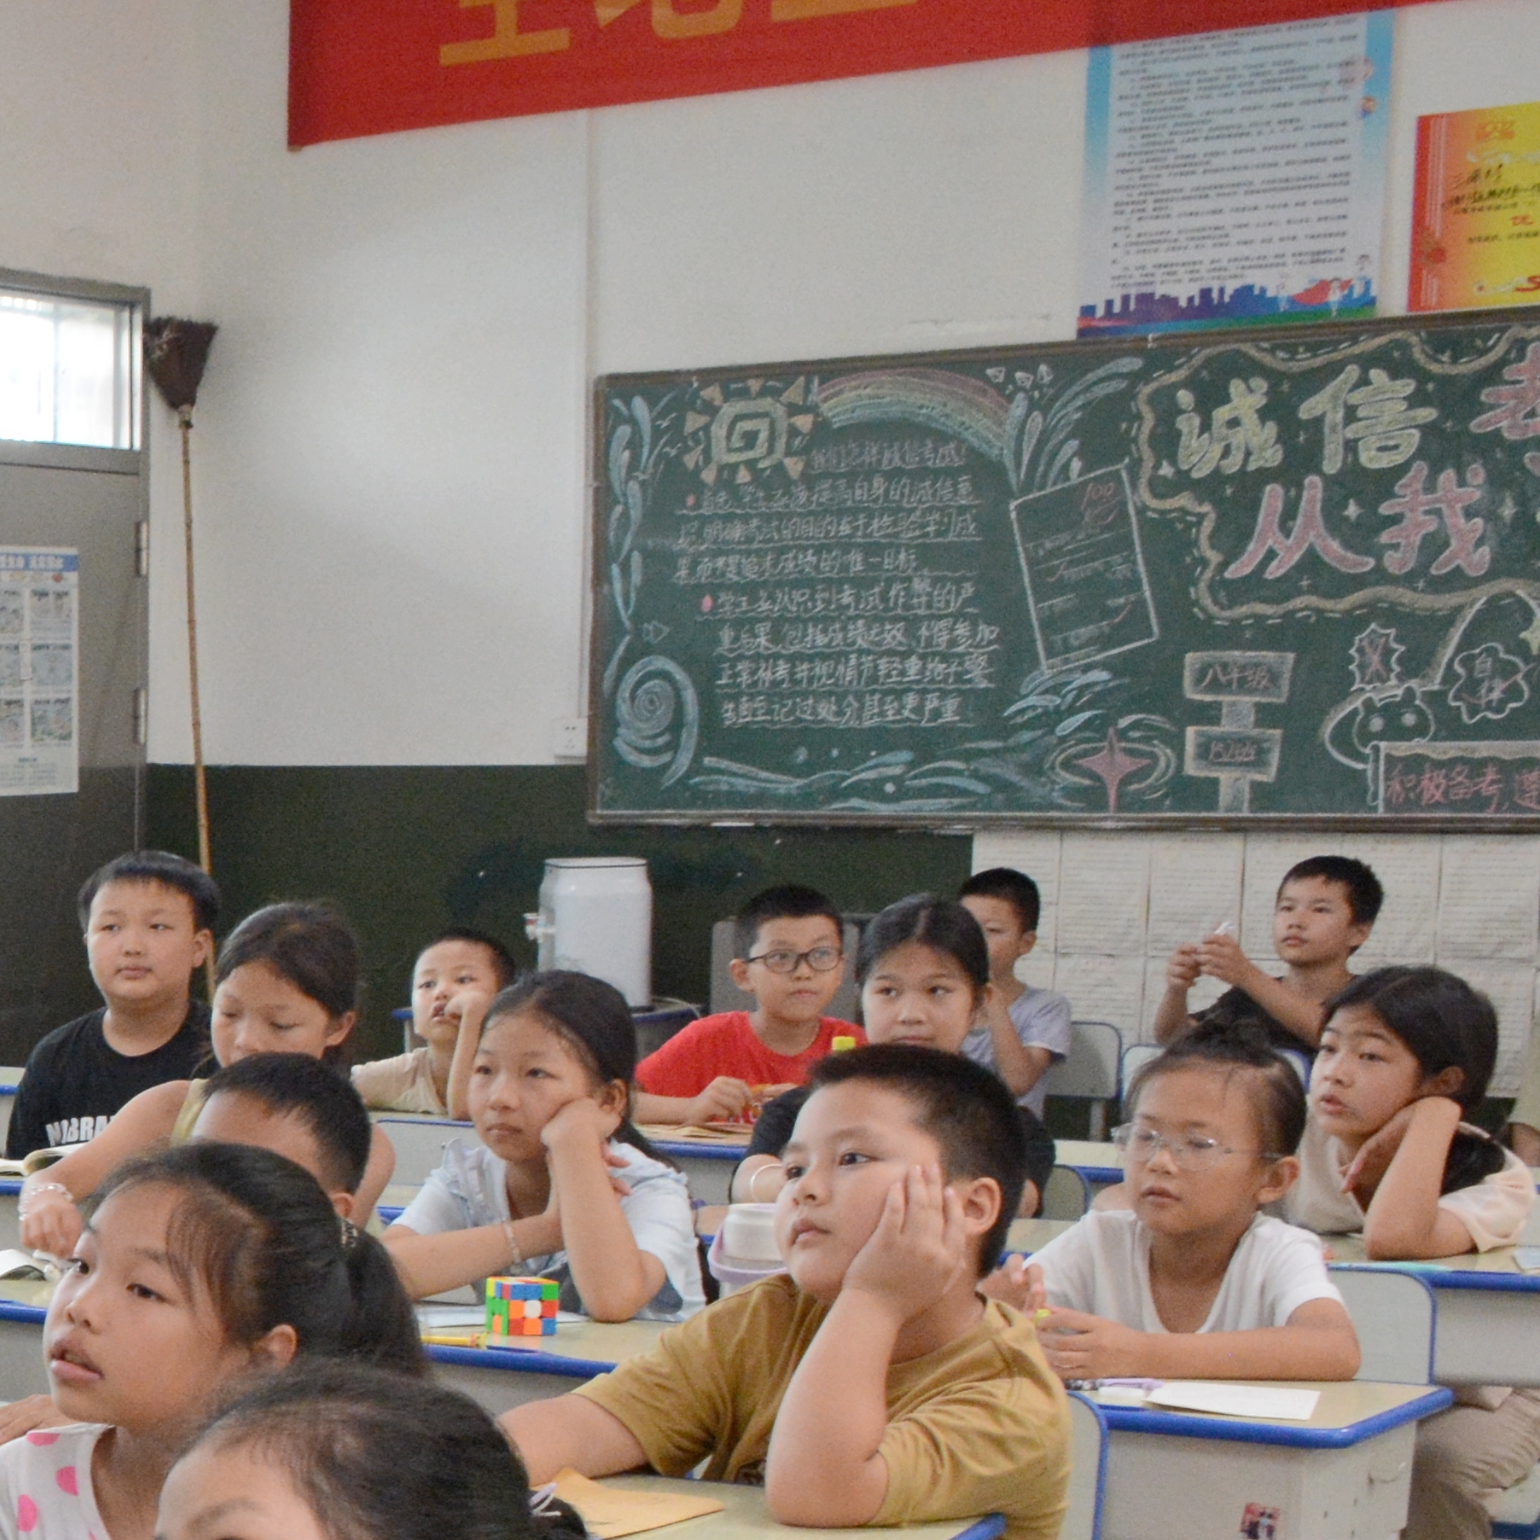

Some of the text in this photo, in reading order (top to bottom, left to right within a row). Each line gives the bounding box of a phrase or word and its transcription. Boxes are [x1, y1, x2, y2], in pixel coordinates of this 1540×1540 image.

[1224, 460, 1491, 579] 从我
[1199, 663, 1271, 690] 八年级
